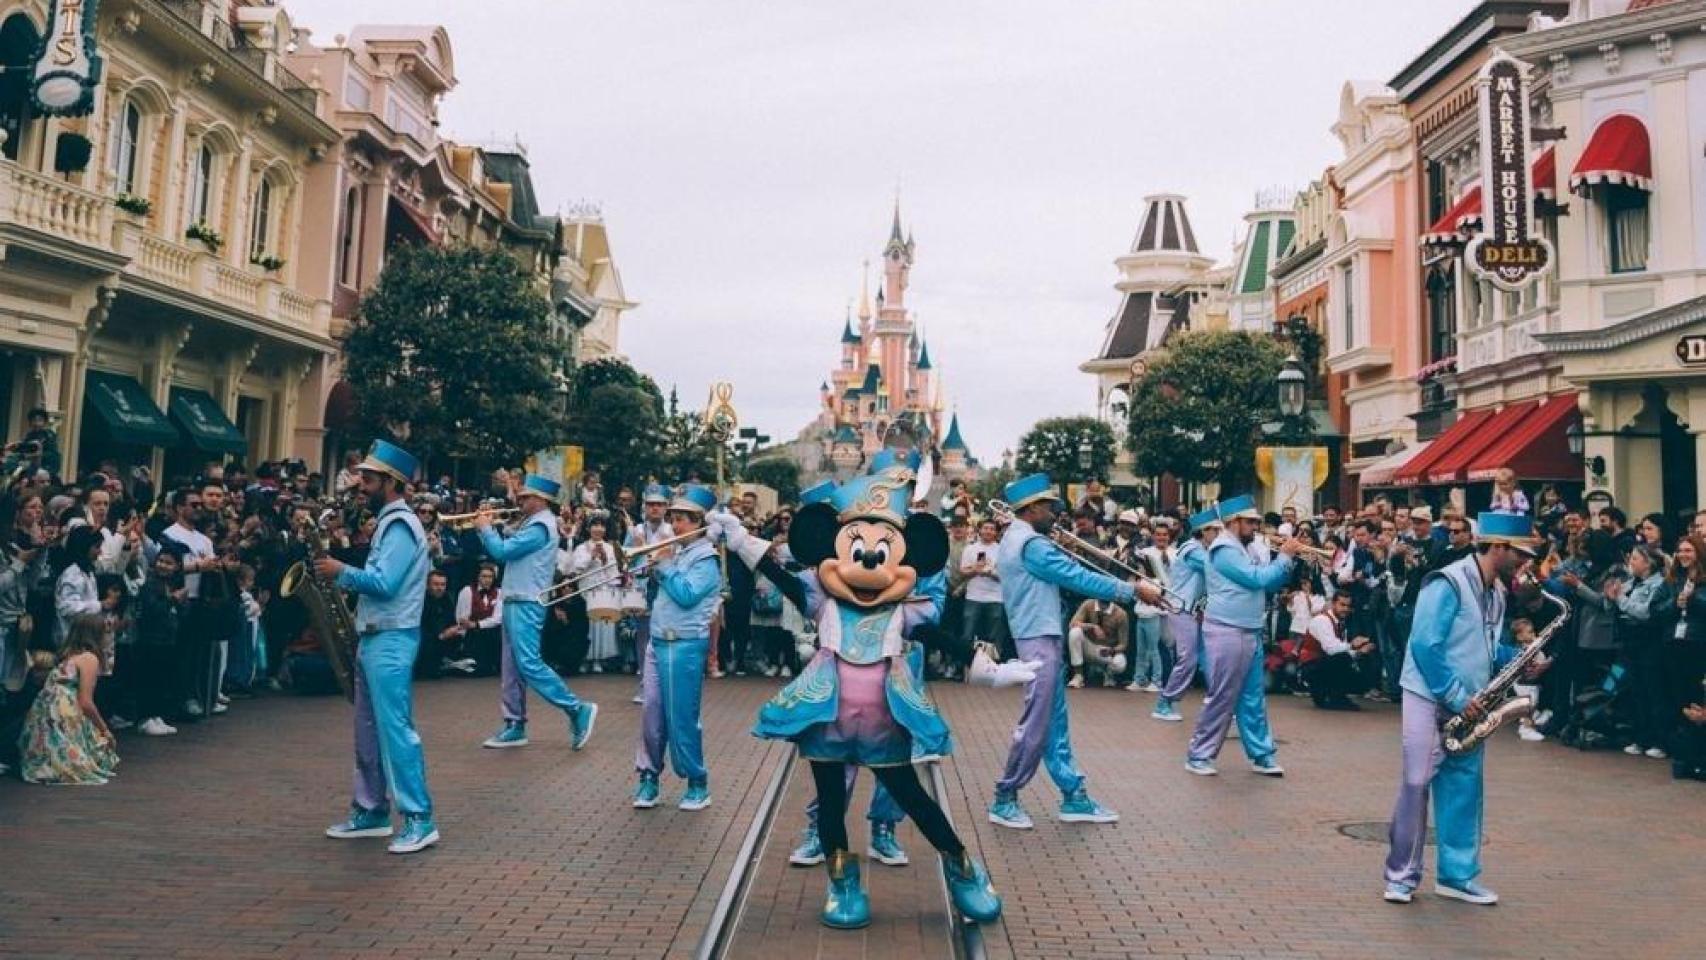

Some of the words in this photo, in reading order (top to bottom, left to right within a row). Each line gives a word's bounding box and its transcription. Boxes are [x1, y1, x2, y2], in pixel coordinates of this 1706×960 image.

[54, 0, 81, 65] TS
[1496, 76, 1516, 164] MARKET
[1501, 171, 1519, 244] HOUSE
[1485, 246, 1537, 263] DELI
